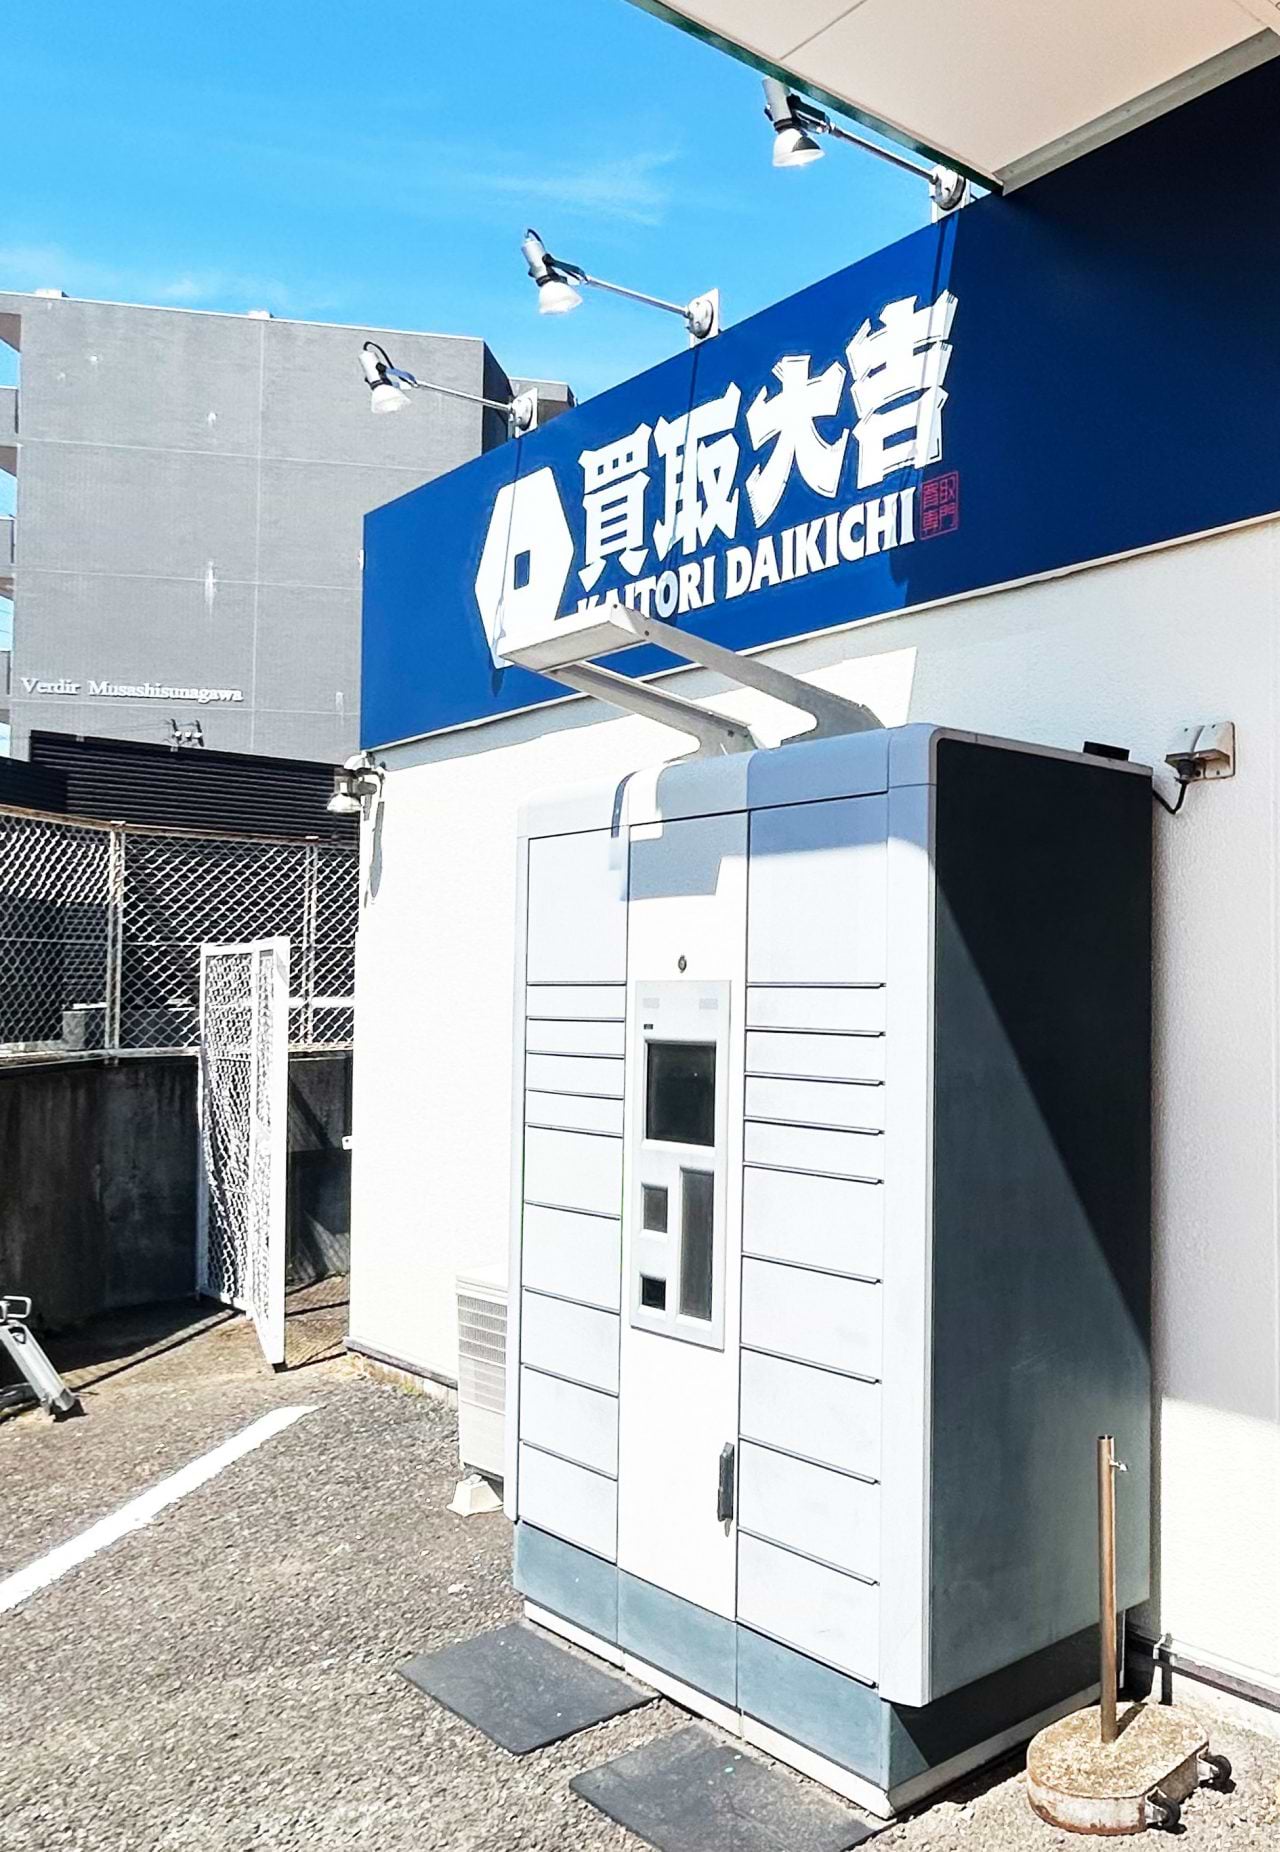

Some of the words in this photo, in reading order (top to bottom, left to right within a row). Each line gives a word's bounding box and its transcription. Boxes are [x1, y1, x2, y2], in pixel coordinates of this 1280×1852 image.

[578, 289, 958, 592] 買取大吉
[725, 487, 917, 600] DAIKICHI
[21, 677, 82, 695] Verdir
[88, 680, 244, 704] Musashisunagawa
